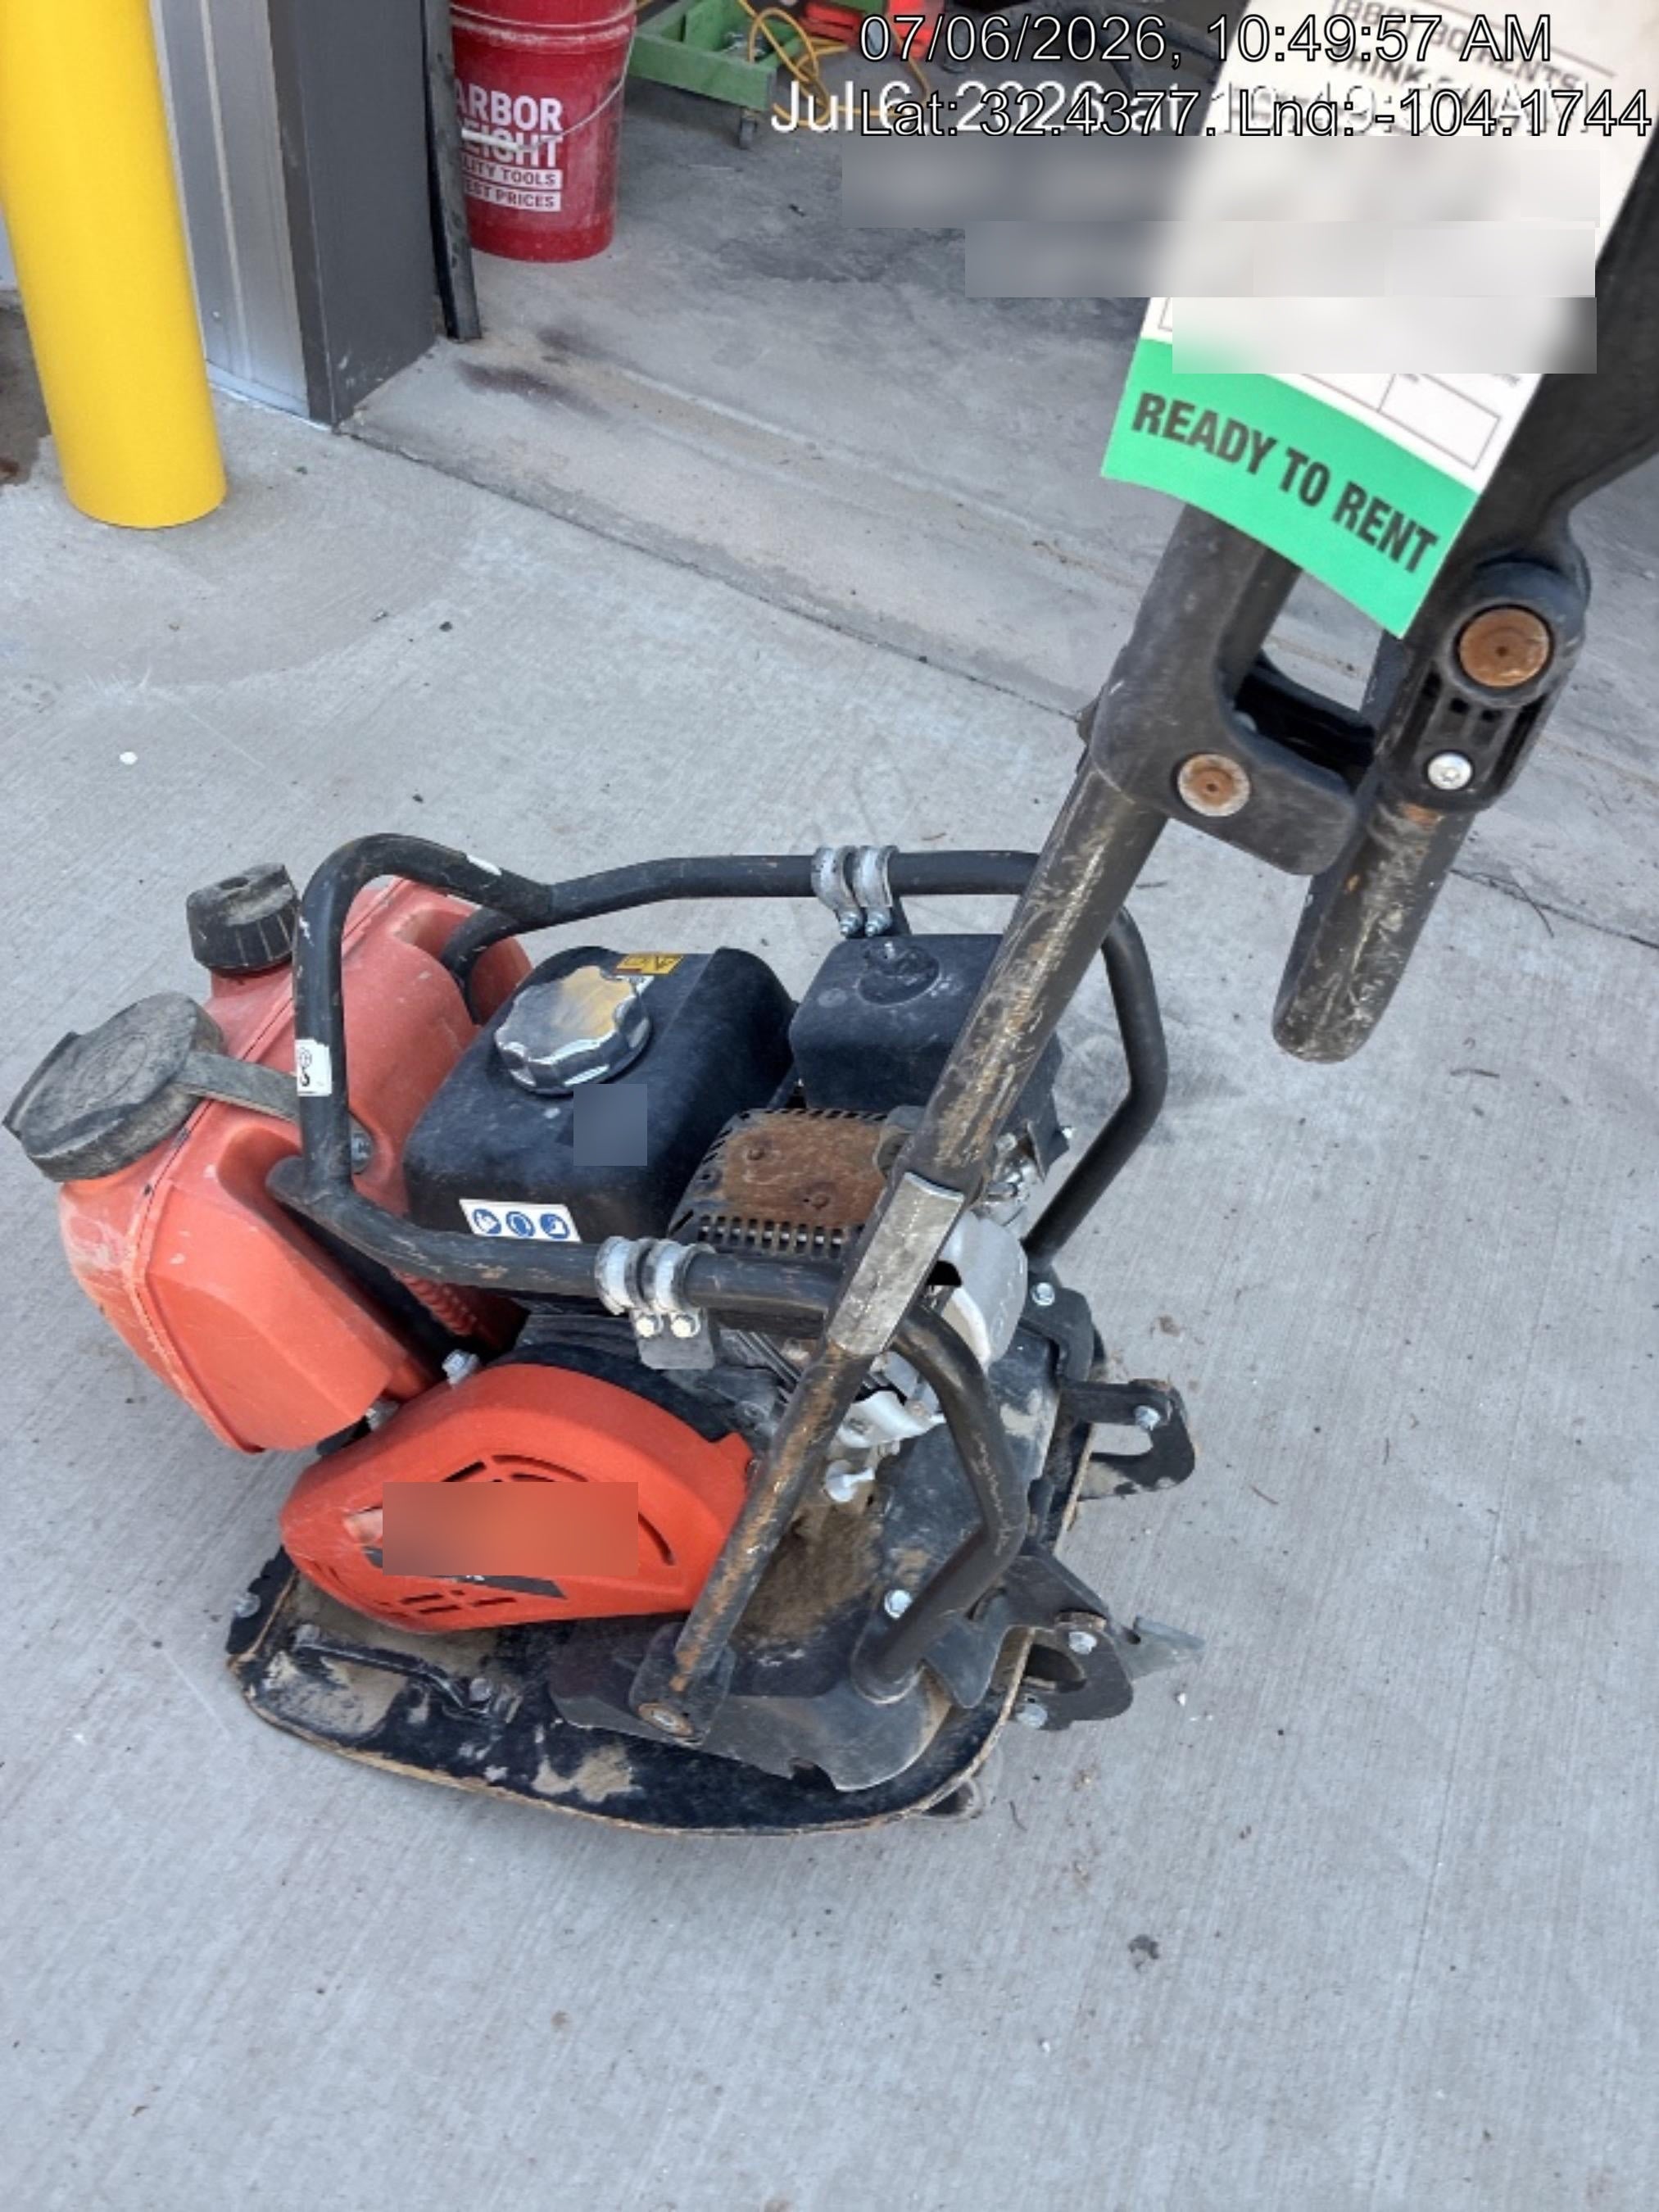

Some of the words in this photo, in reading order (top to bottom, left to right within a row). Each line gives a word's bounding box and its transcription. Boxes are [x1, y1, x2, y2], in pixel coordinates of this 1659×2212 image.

[457, 116, 564, 168] EIGHT
[502, 168, 555, 186] TOOLS
[496, 188, 555, 208] PRICES
[1131, 392, 1277, 476] READY
[1278, 447, 1330, 507] TO
[1330, 481, 1439, 573] RENT
